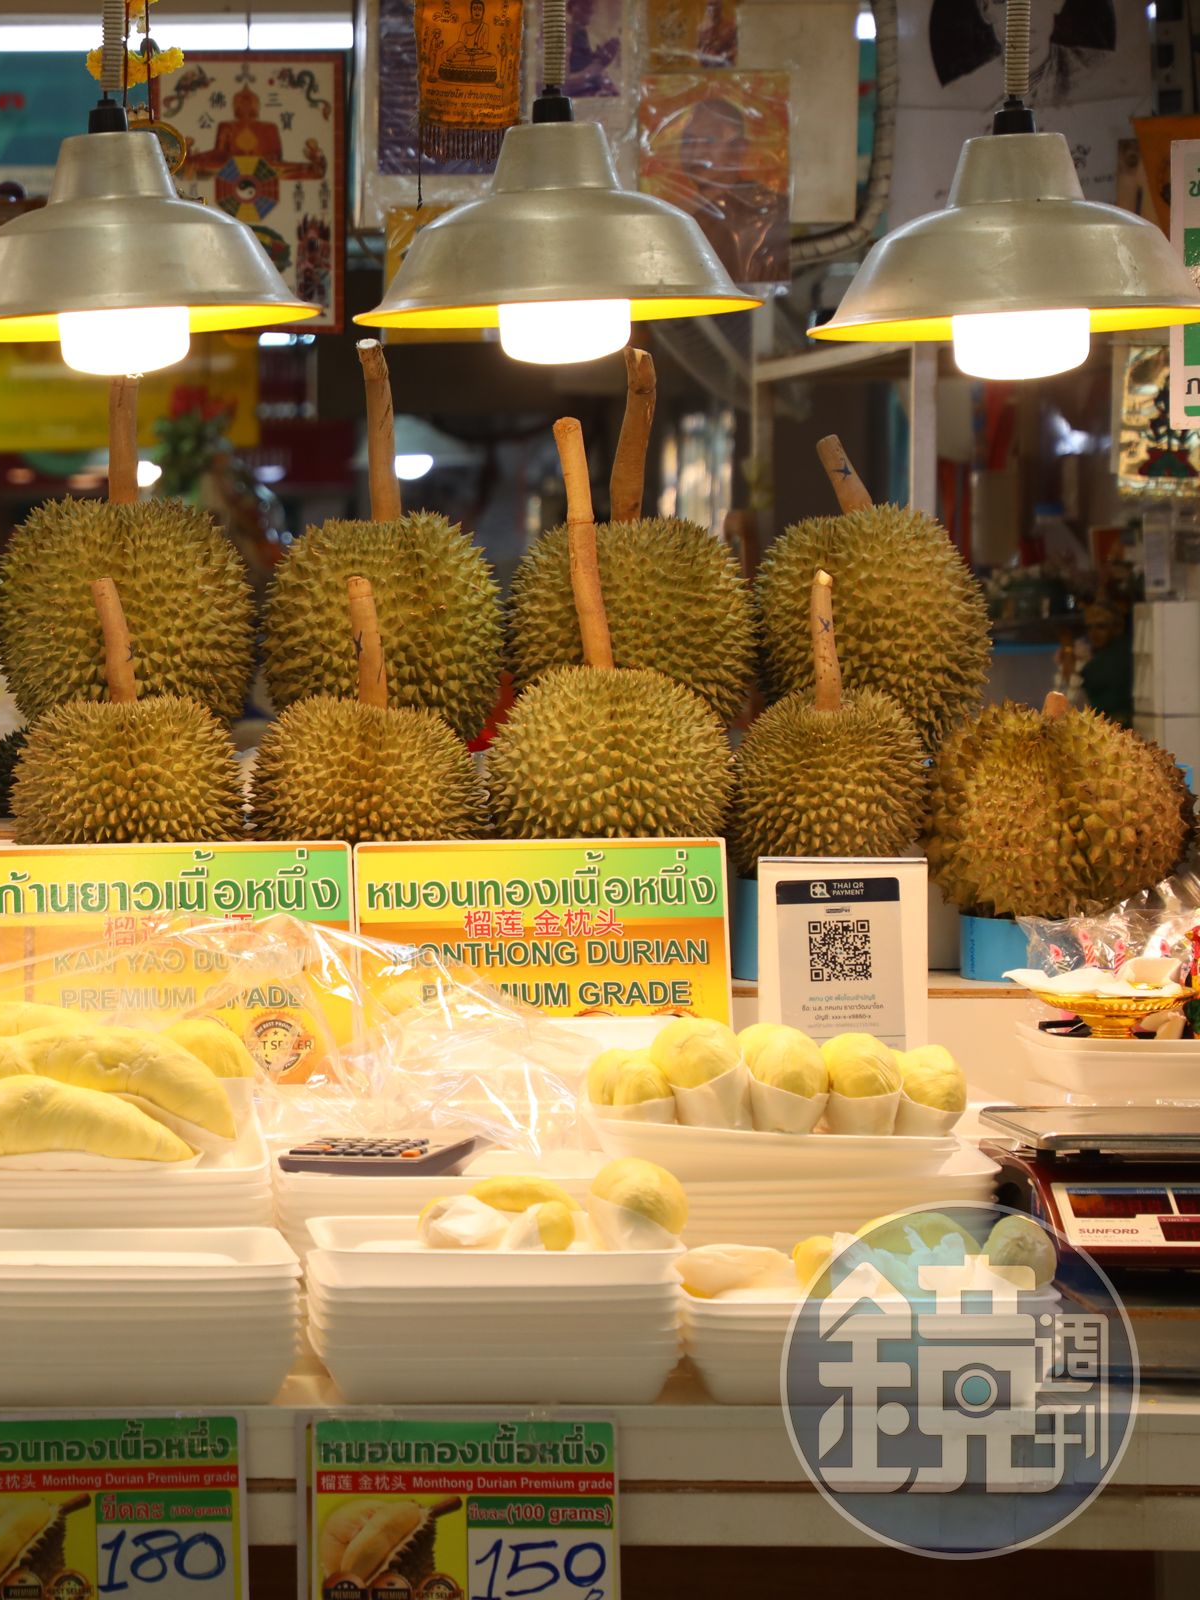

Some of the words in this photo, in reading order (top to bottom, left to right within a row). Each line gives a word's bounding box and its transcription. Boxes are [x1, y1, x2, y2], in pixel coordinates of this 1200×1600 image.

[367, 851, 716, 909] หมอนทองเนื้อหนึ่ง
[853, 881, 864, 889] QR
[464, 910, 524, 937] 榴莲
[533, 909, 623, 936] 金枕头
[53, 951, 115, 974] KAN
[126, 949, 185, 972] YAO
[588, 939, 707, 964] DURIAN
[60, 986, 197, 1010] PREMIUM
[578, 980, 691, 1006] GRADE
[321, 1424, 607, 1465] หมอนทองเนื้อหนึ่ง
[42, 1474, 102, 1489] Monthong
[105, 1473, 144, 1485] Durian
[147, 1472, 200, 1484] Premium
[203, 1471, 237, 1485] grade
[321, 1475, 353, 1491] 榴莲
[358, 1475, 406, 1491] 金枕头
[412, 1477, 473, 1491] Monthong
[477, 1477, 517, 1489] Durian
[521, 1477, 574, 1489] Premium
[578, 1478, 613, 1491] grade
[102, 1494, 164, 1521] ขีดละ
[550, 1505, 612, 1526] grams)
[97, 1528, 226, 1593] 180
[472, 1538, 607, 1600] 150
